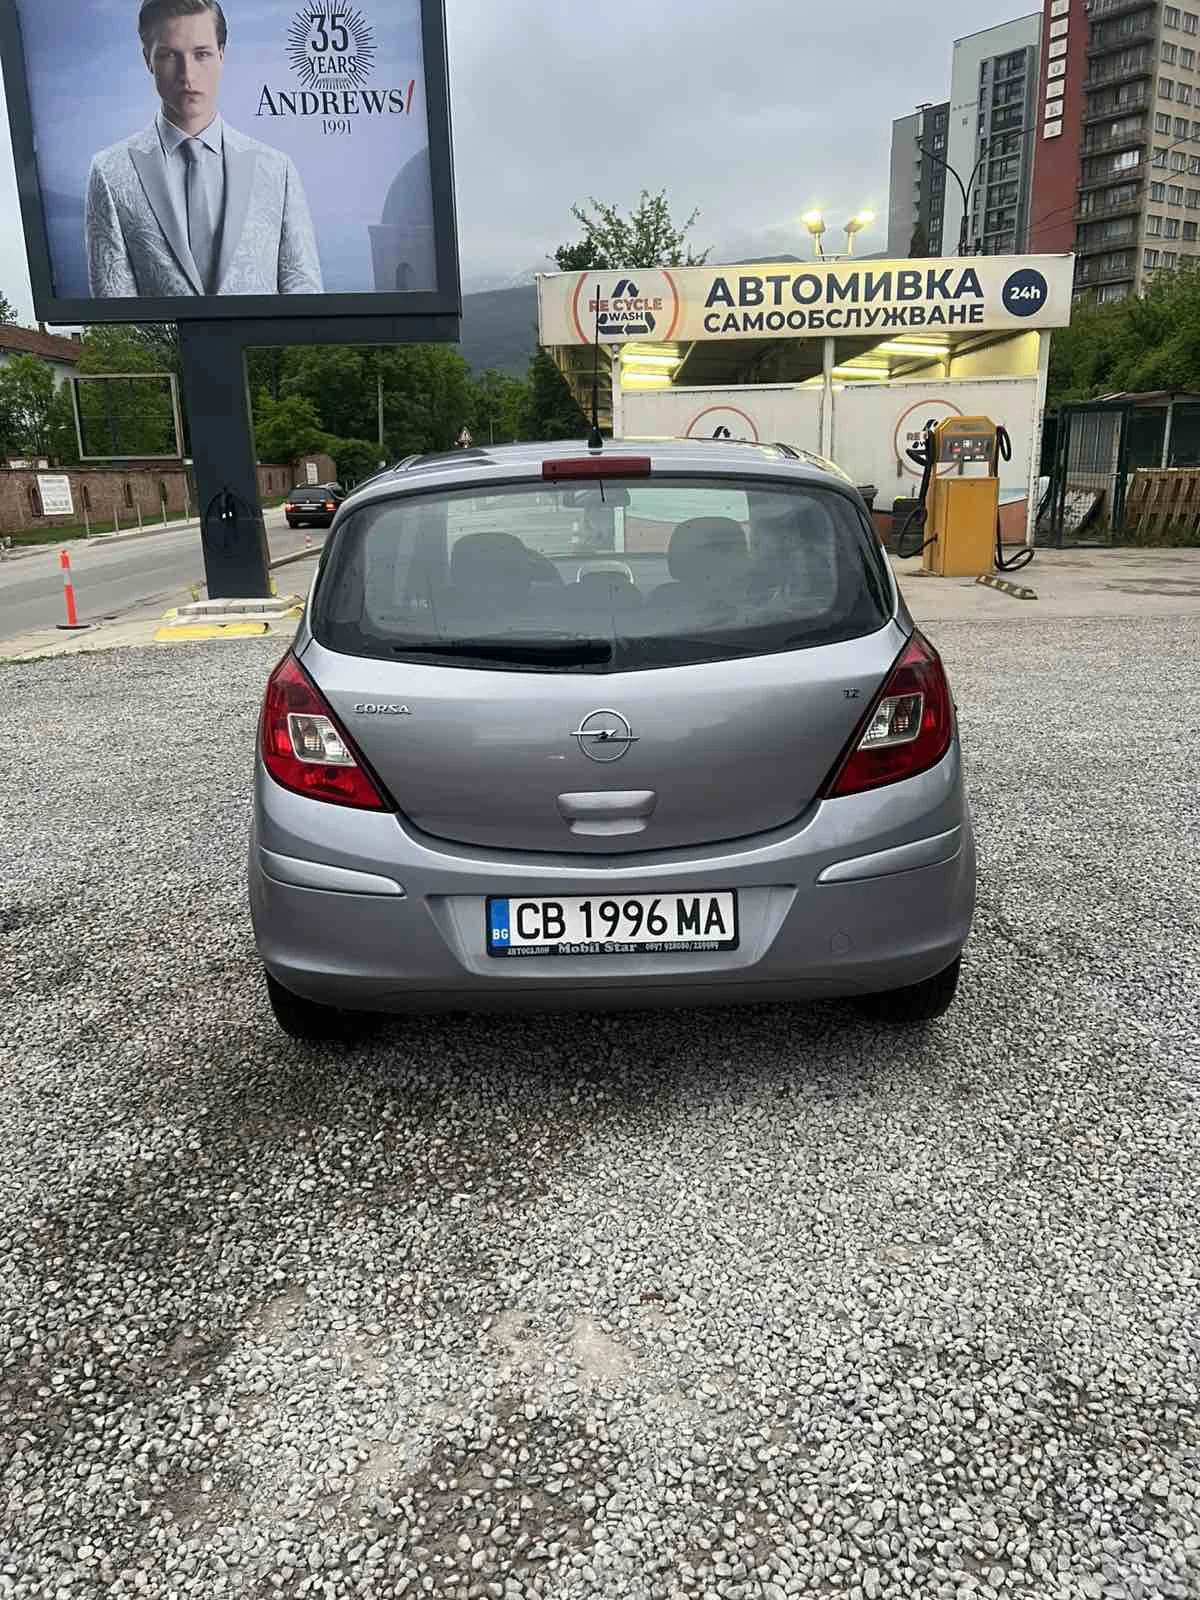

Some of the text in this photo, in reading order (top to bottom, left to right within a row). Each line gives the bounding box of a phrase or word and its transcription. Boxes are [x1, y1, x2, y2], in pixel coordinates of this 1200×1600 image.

[310, 14, 349, 52] 35
[307, 56, 357, 74] YEARS
[321, 119, 352, 135] 1991
[704, 267, 984, 308] АВТОМИВКА
[1010, 286, 1041, 300] 24h
[588, 297, 663, 313] RE CYCLE
[609, 311, 644, 321] WASH
[704, 304, 984, 333] САМООБСЛУЖВАНЕ
[353, 703, 410, 714] CORSA
[516, 897, 726, 939] CB 1996 MA
[492, 929, 509, 940] BG
[558, 942, 601, 954] Mobil
[603, 941, 637, 953] Star
